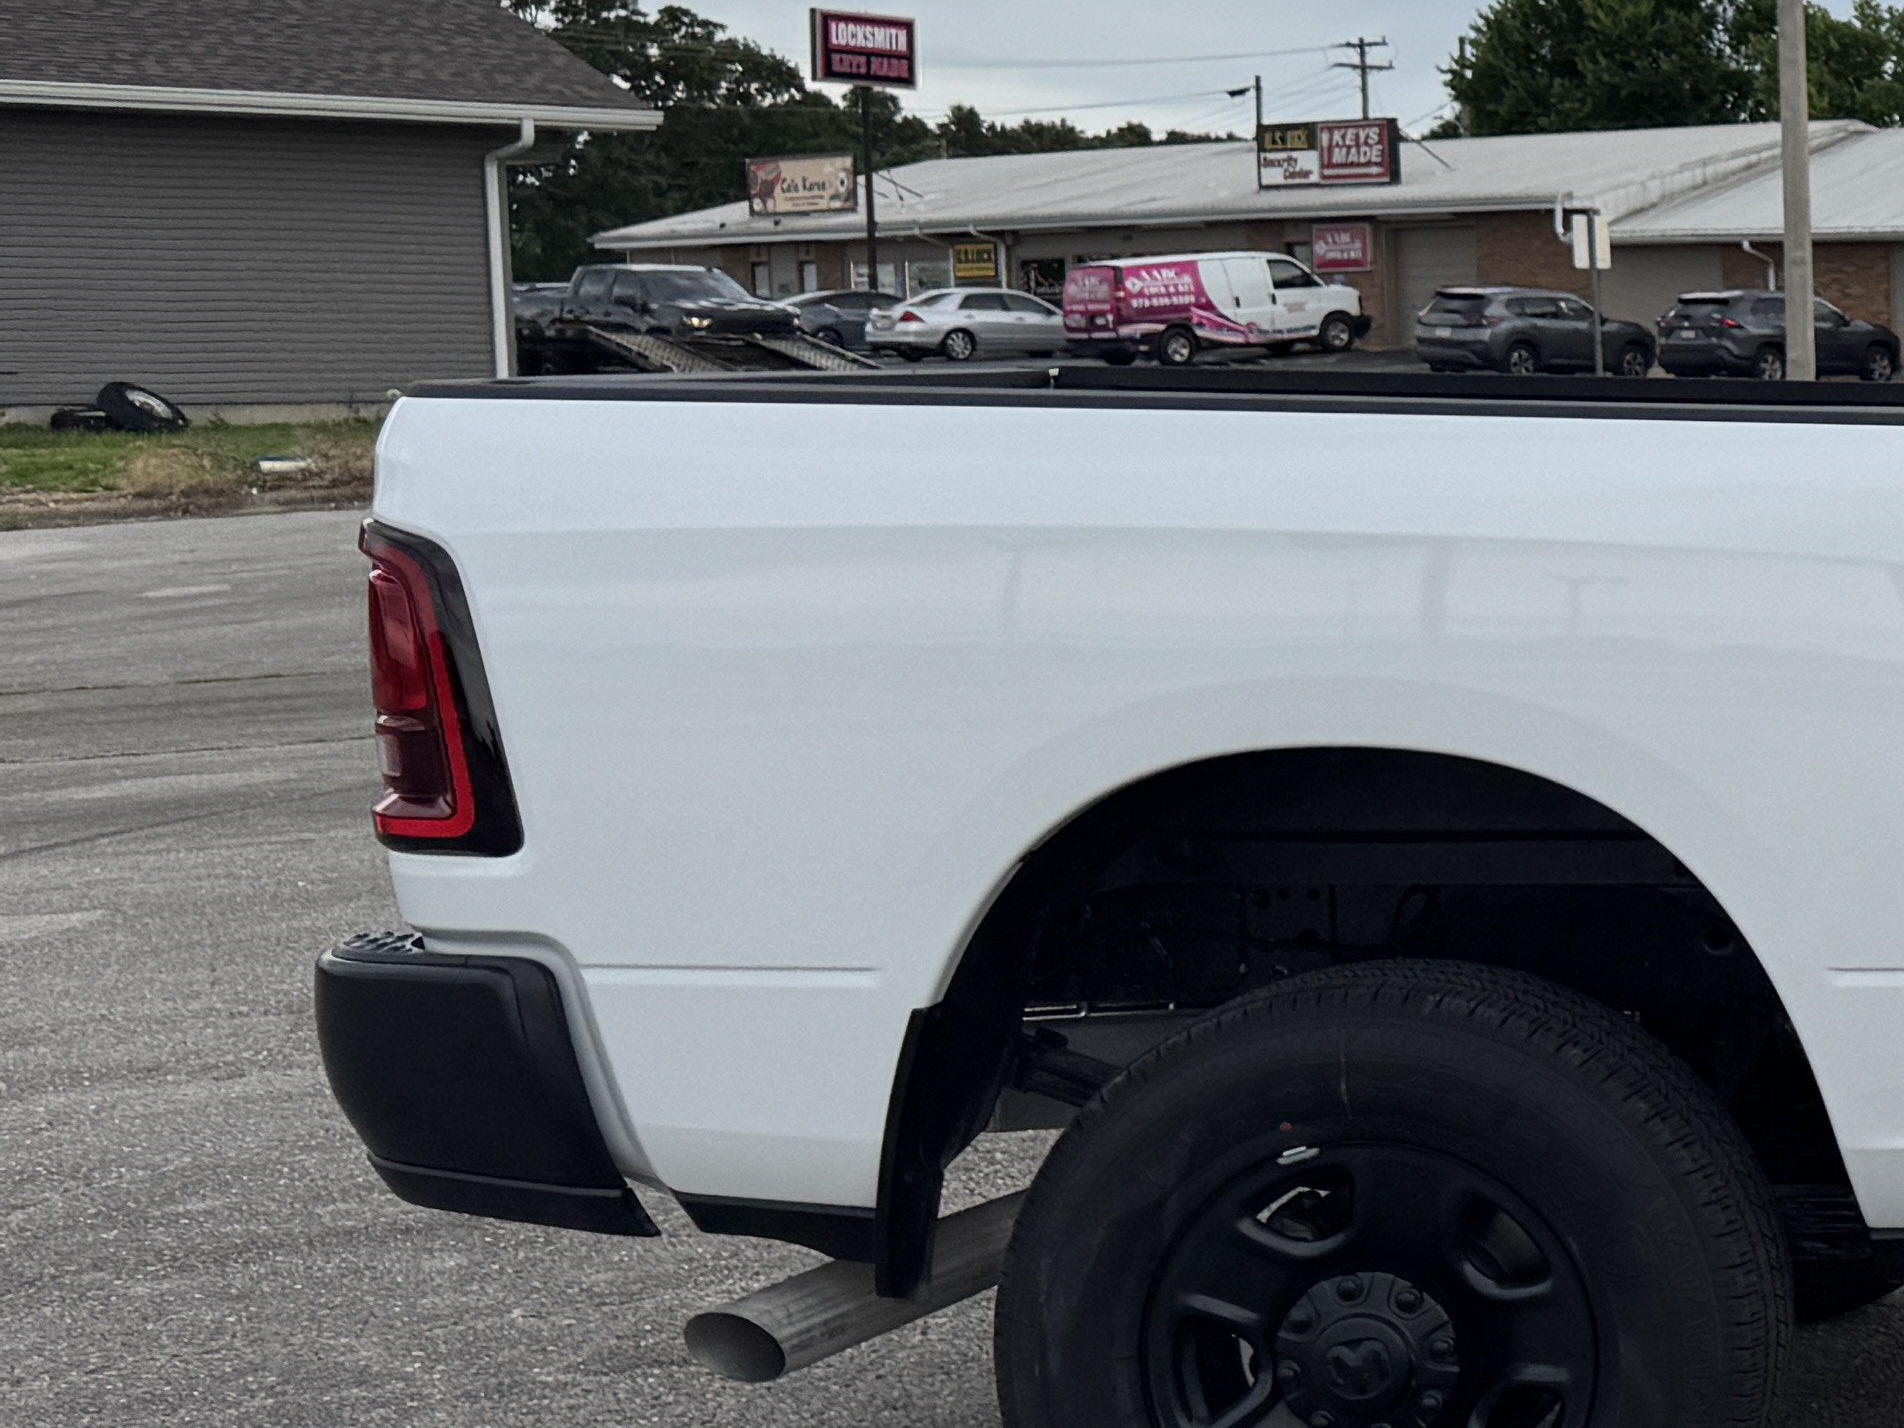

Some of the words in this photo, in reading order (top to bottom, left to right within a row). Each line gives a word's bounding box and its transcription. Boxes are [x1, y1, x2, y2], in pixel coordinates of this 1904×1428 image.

[830, 21, 907, 52] LOCKSMITH
[831, 53, 867, 75] KEYS
[870, 56, 909, 79] MADE
[1332, 126, 1380, 147] KEYS
[1332, 144, 1383, 164] MADE
